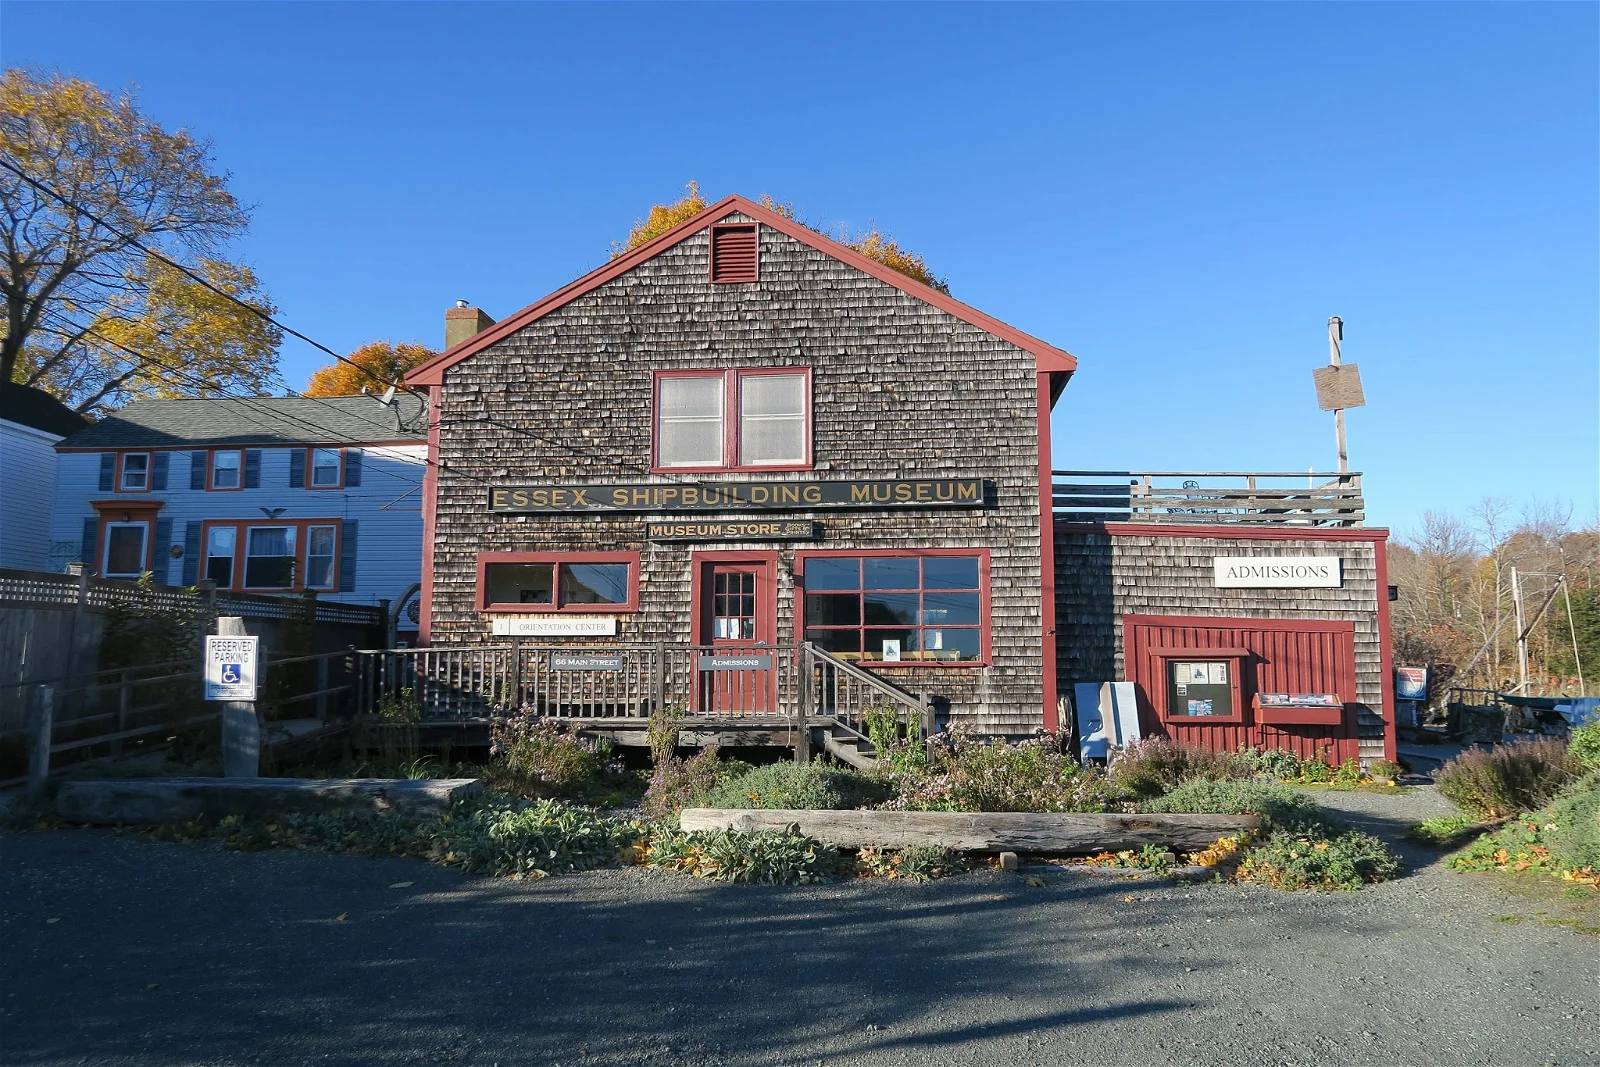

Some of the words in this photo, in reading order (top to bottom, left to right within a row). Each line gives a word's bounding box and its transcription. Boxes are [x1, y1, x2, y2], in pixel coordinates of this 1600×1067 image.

[493, 489, 588, 507] ESSEX
[612, 485, 822, 506] SHIPBUILDING
[851, 482, 977, 501] MUSEUM
[650, 525, 722, 536] MUSEUM
[727, 523, 781, 535] STORE
[1227, 565, 1329, 578] ADMISSIONS
[519, 623, 571, 631] ORIENTATION
[211, 641, 252, 652] RESERVED
[214, 652, 249, 663] PARKING
[555, 658, 567, 666] 66
